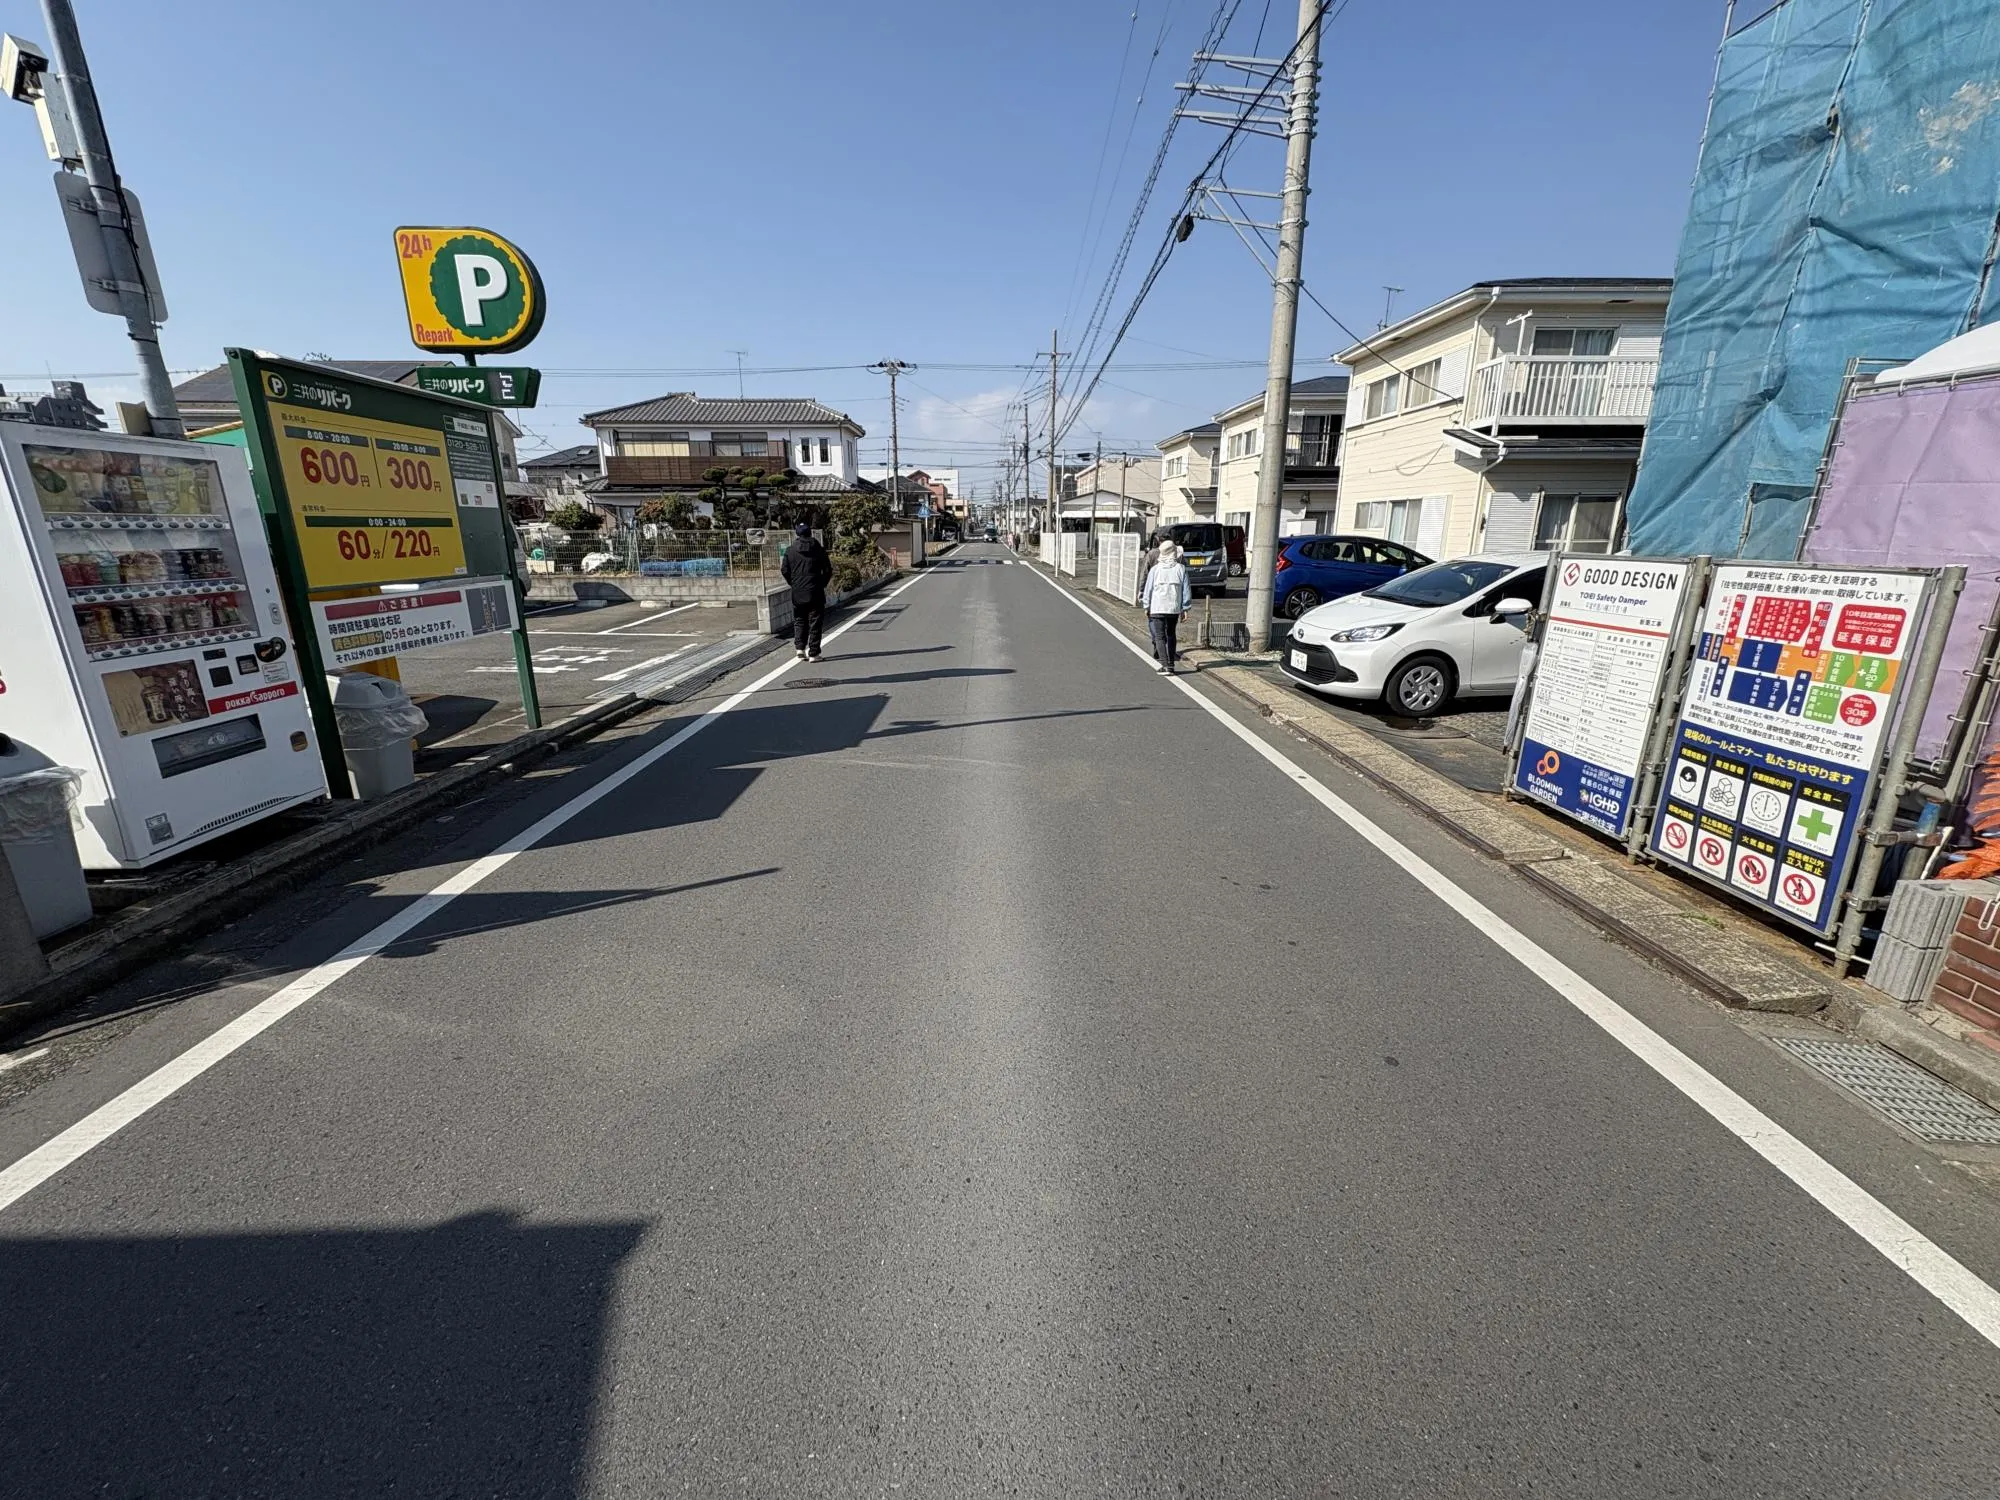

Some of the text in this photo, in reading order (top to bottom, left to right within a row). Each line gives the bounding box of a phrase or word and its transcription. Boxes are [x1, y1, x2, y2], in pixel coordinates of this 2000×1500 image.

[400, 234, 433, 259] 24h
[453, 253, 508, 328] P
[415, 323, 455, 345] Repark
[271, 377, 283, 394] P
[424, 377, 485, 393] 三井のリパーク
[292, 383, 352, 410] 三井のリパーク
[1583, 567, 1679, 590] GOOD DESIGN
[1595, 592, 1617, 603] Safety
[1617, 595, 1648, 607] Damper
[1835, 630, 1894, 648] 延長保証
[1683, 727, 1764, 760] 現場のルールとマナー
[1763, 751, 1854, 788] 私たちは守ります
[1527, 772, 1564, 796] BLOOMING
[1528, 783, 1558, 805] GARDEN
[1802, 785, 1843, 807] 安全第一
[1741, 834, 1774, 854] 火気厳禁
[1785, 855, 1823, 877] 立入禁止
[1787, 847, 1825, 869] 関係者以外
